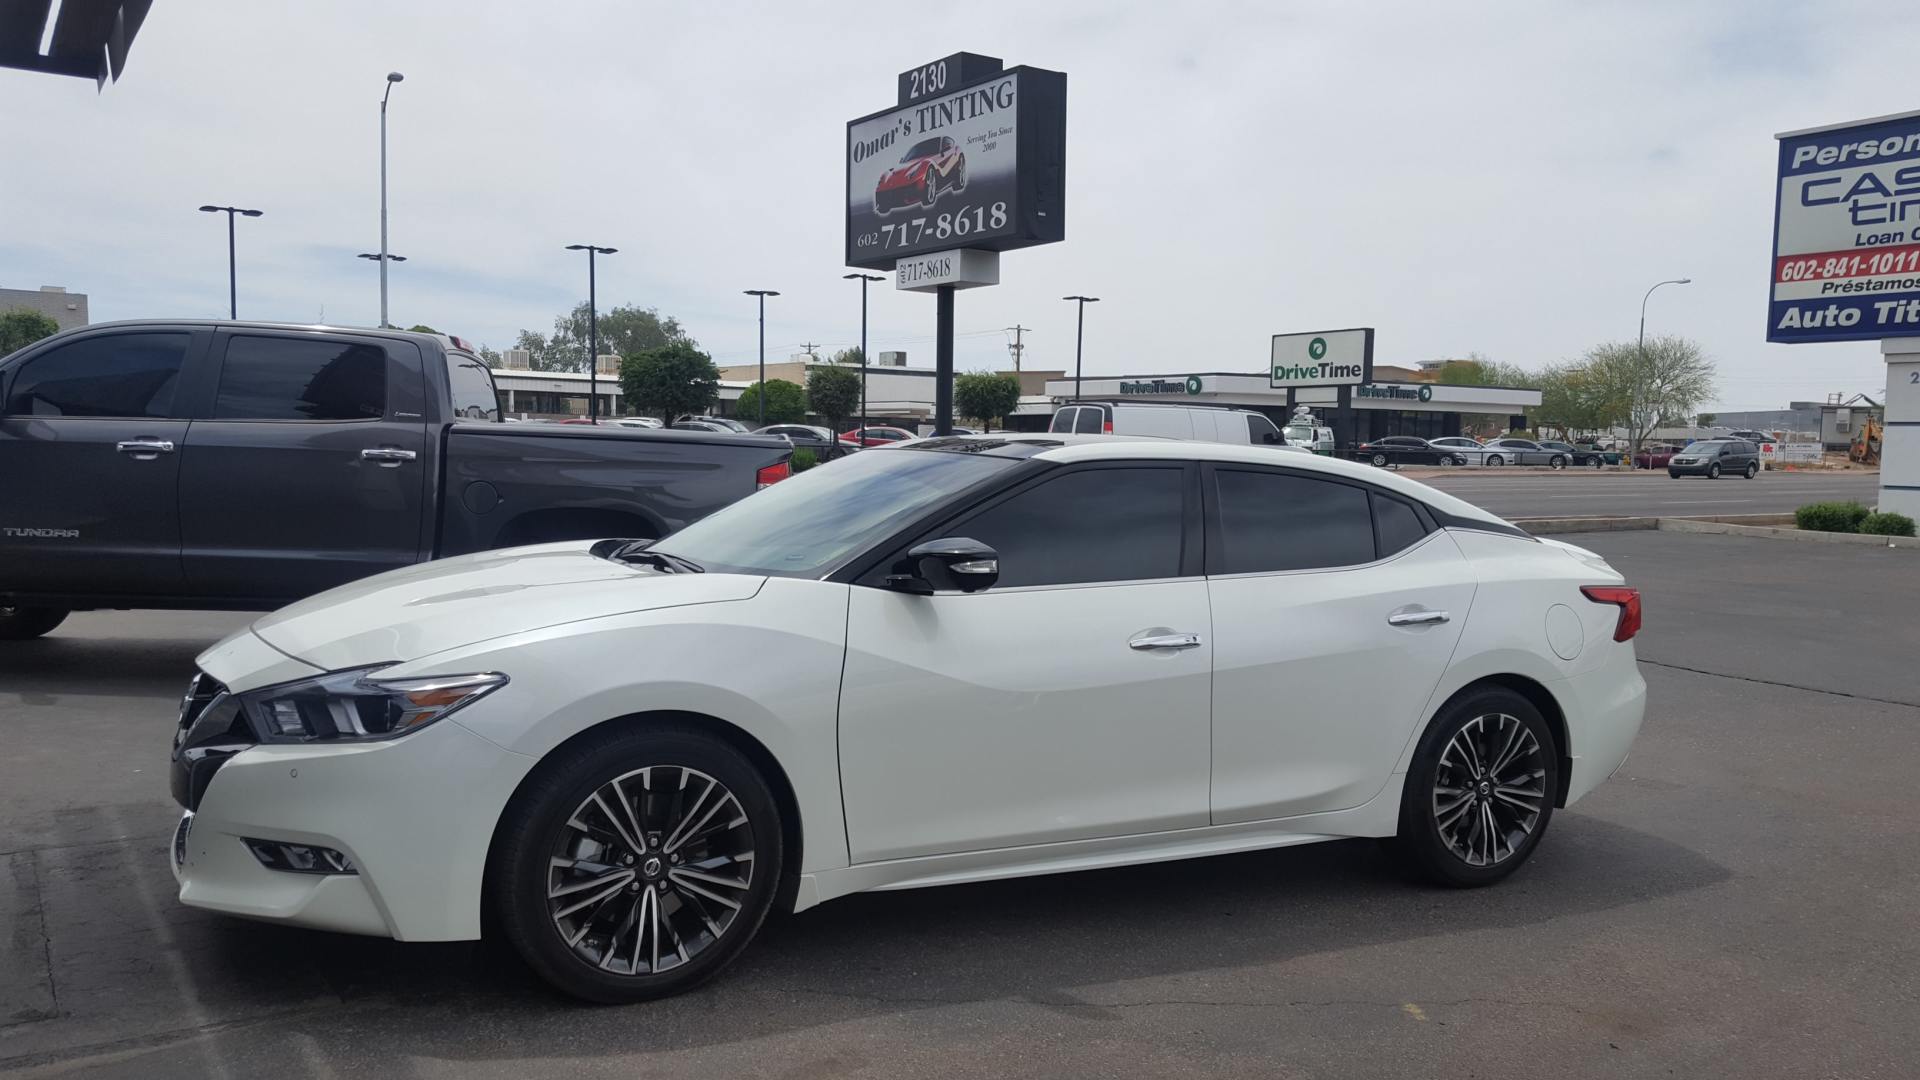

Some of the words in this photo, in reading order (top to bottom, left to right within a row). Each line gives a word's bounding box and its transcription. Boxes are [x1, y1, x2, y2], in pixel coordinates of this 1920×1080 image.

[910, 60, 947, 99] 2130
[853, 117, 912, 163] Omar's
[915, 80, 1015, 134] TINTING
[1791, 132, 1920, 169] Person
[857, 232, 879, 248] 602
[881, 201, 1008, 250] 717-8618
[1855, 231, 1905, 247] Loan
[907, 257, 951, 281] 717-8618
[1781, 249, 1920, 283] 602-841-1011
[1777, 303, 1862, 330] Auto
[1874, 298, 1920, 325] Tit
[1119, 380, 1185, 394] DriveTime
[1273, 361, 1362, 382] DriveTime
[3, 526, 80, 538] TUNDRA
